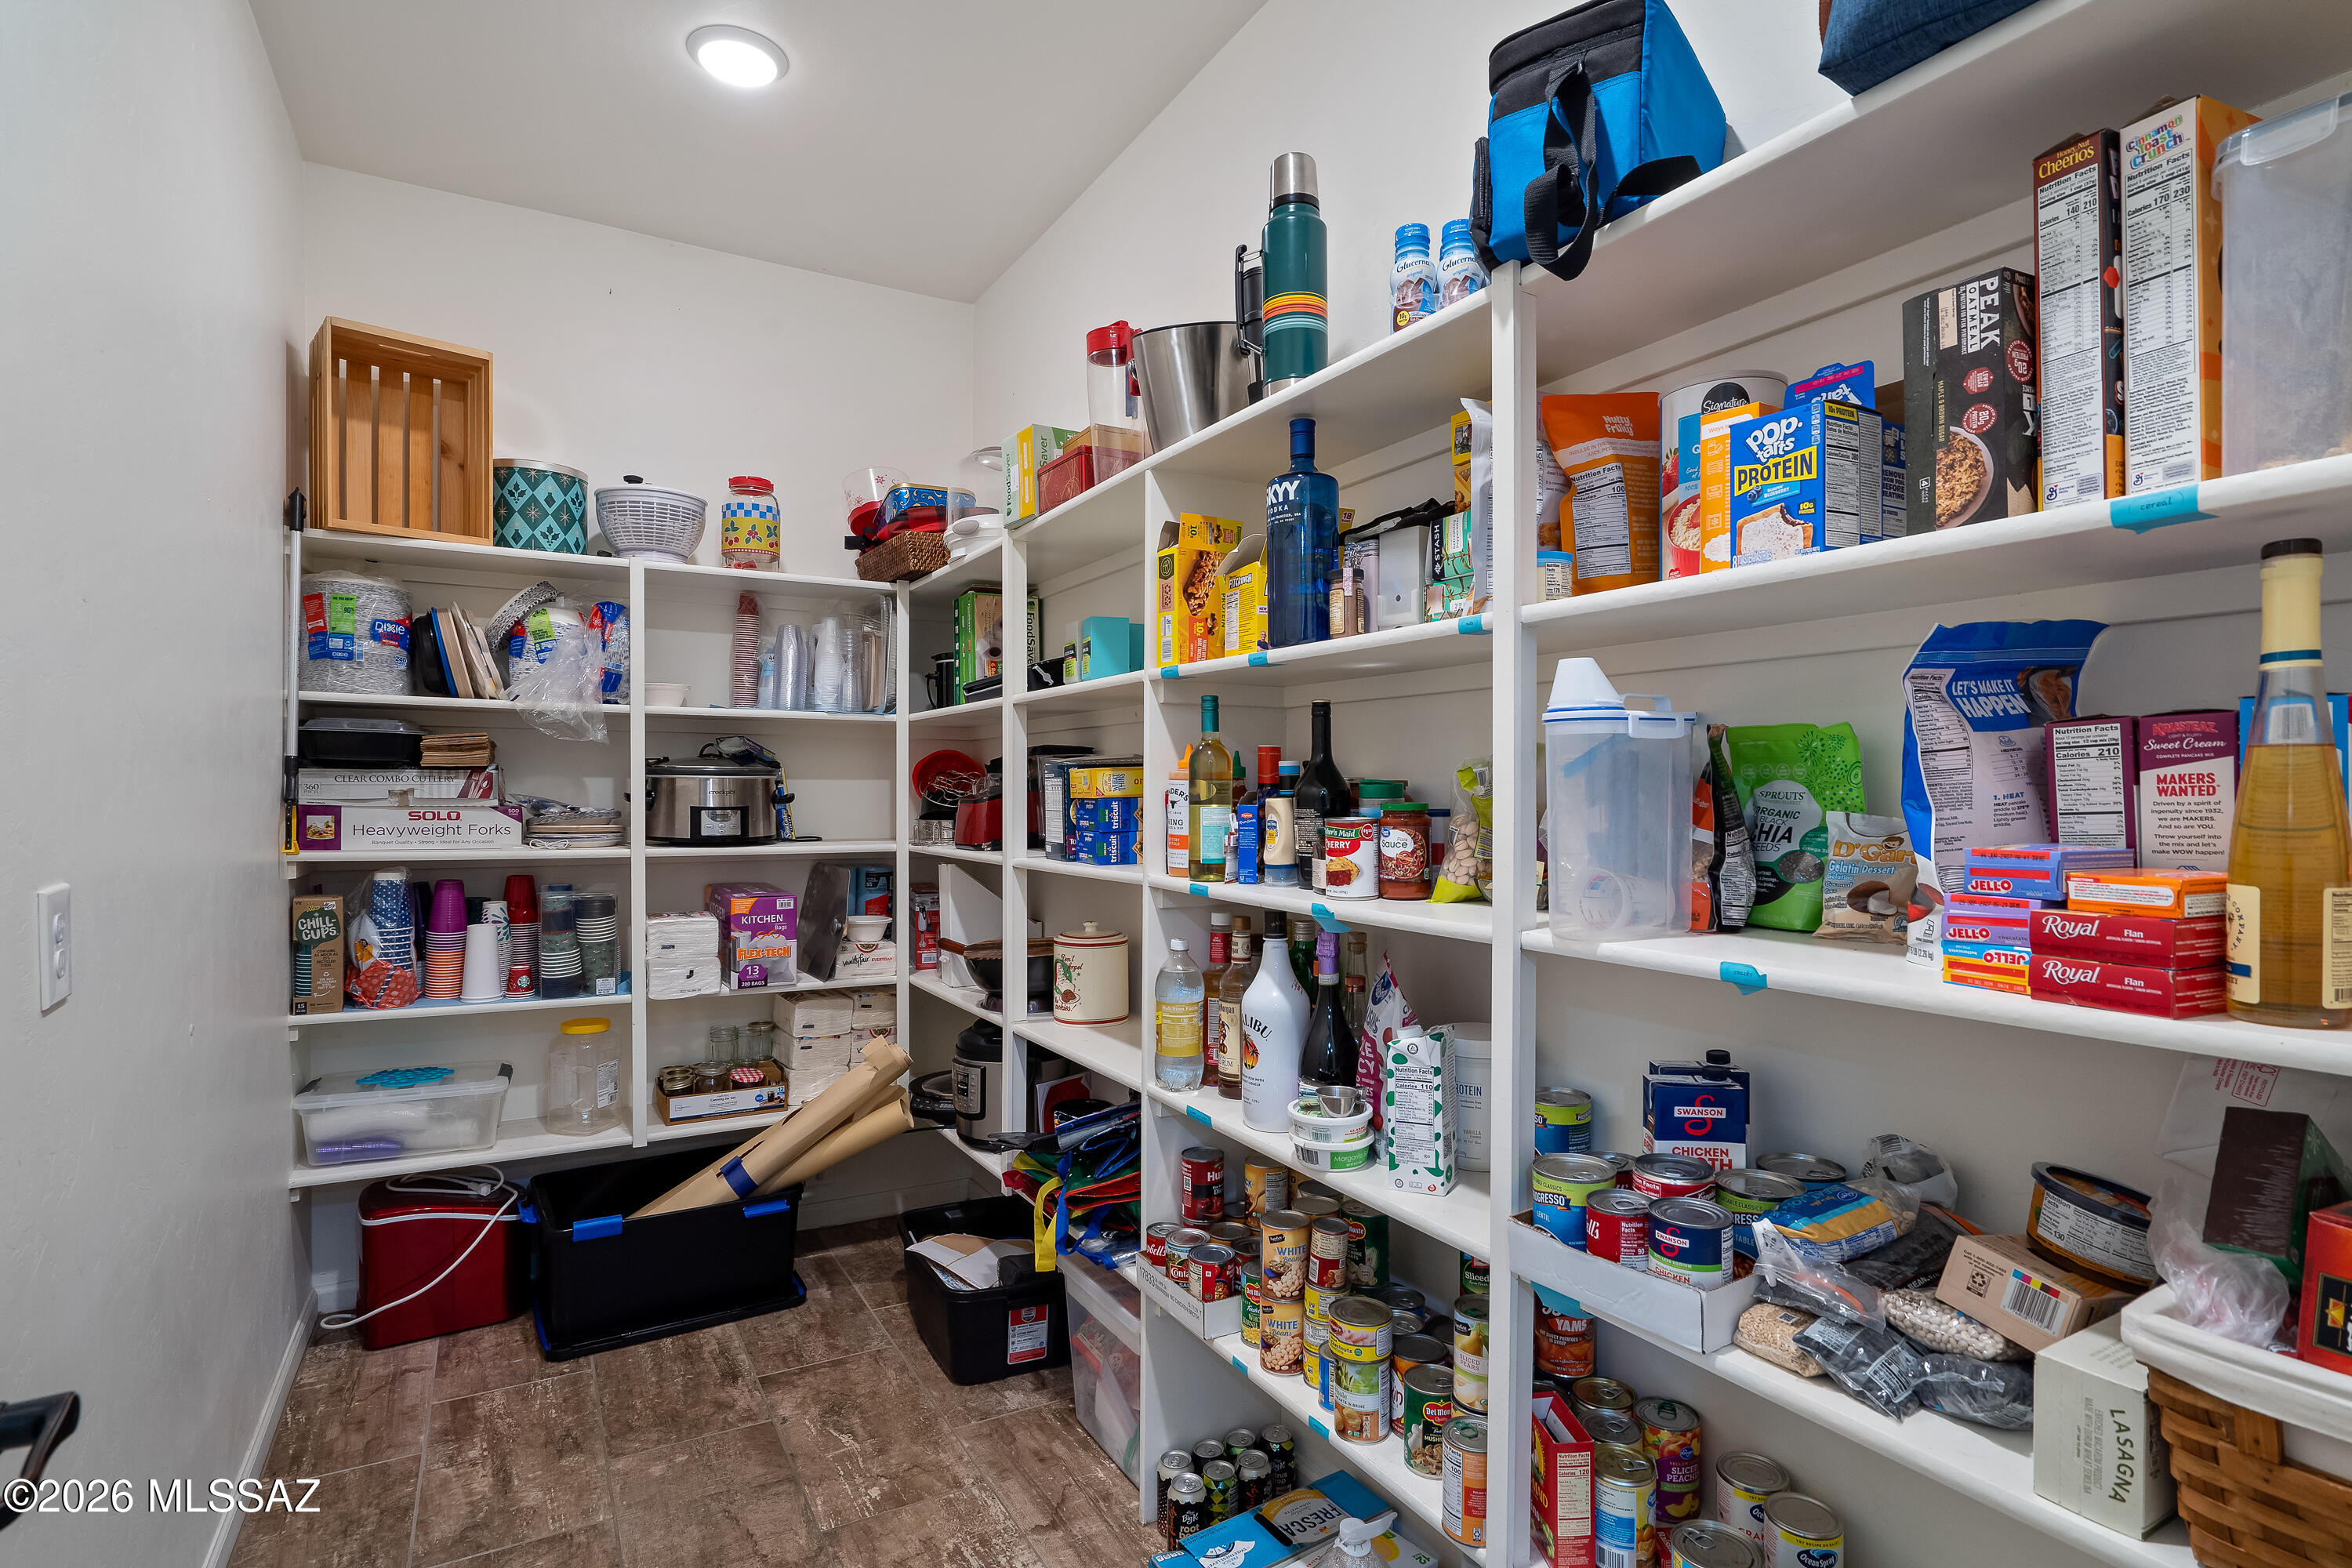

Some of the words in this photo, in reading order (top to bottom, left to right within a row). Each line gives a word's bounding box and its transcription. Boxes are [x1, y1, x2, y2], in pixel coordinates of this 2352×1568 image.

[2126, 115, 2183, 152] Cinnamon
[2057, 148, 2076, 158] Honey
[2078, 140, 2089, 149] Nut
[2139, 130, 2172, 154] Toast
[2131, 132, 2183, 169] Crunch
[2039, 146, 2094, 179] Cheerios
[2127, 163, 2162, 182] Nutrition
[2166, 152, 2190, 164] Facts
[2039, 176, 2071, 194] Nutrition
[2074, 166, 2096, 177] Facts
[2154, 193, 2169, 206] 170
[2173, 186, 2190, 198] 230
[2066, 205, 2080, 216] 140
[2083, 198, 2097, 209] 210
[1397, 259, 1430, 272] Glucerna
[1443, 256, 1476, 271] Glucerna
[1969, 287, 1978, 349] OATMEAL
[1980, 276, 2000, 350] PEAK
[1703, 398, 1748, 414] Signature
[1835, 407, 1855, 419] PROTEIN
[1978, 410, 1989, 425] 20g
[1569, 446, 1591, 456] INDULGE
[1571, 468, 1602, 483] Nutrition
[1603, 463, 1622, 474] Facts
[1738, 450, 1813, 491] PROTEIN
[1764, 487, 1790, 498] BLUEBERRY
[2140, 495, 2173, 511] cereal
[1951, 680, 1978, 695] LET'S
[1980, 679, 2006, 694] MAKE
[2006, 679, 2015, 691] IT
[1956, 693, 2031, 718] HAPPEN
[2095, 724, 2119, 733] Facts
[2152, 720, 2218, 736] KRUSTEAZ
[2143, 739, 2181, 751] Sweet
[2183, 737, 2227, 750] Cream
[2098, 747, 2120, 756] 210
[2156, 772, 2216, 785] MAKERS
[1759, 790, 1806, 801] SPROUTS
[2156, 785, 2216, 797] WANTED
[408, 811, 461, 821] SOLO
[1109, 800, 1119, 829] triscuit
[1753, 806, 1801, 820] ORGANIC
[1759, 815, 1788, 826] BLACK
[353, 823, 462, 838] Heavyweight
[468, 823, 511, 835] Forks
[1339, 828, 1356, 838] Maid
[1752, 824, 1793, 844] CHIA
[1108, 834, 1116, 863] triscuit
[1381, 840, 1408, 848] Sauce
[1752, 842, 1780, 852] SEEDS
[1828, 860, 1860, 874] Gelatin
[1861, 864, 1895, 876] Dessert
[1828, 872, 1854, 881] Gelatina
[298, 916, 336, 931] CHILL-
[741, 914, 783, 925] KITCHEN
[2042, 915, 2100, 940] Royal
[2124, 928, 2143, 938] Flan
[737, 946, 791, 961] FLEX-TECH
[746, 965, 759, 975] 13
[2042, 960, 2101, 985] Royal
[2125, 978, 2144, 987] Flan
[1677, 1108, 1723, 1116] SWANSON
[1334, 1153, 1363, 1163] Margarita
[1671, 1147, 1730, 1158] CHICKEN
[1543, 1181, 1563, 1192] CLASSICS
[1738, 1202, 1763, 1212] CLASSICS
[2045, 1192, 2071, 1210] Nutrition
[1537, 1210, 1550, 1222] LENTIL
[1657, 1232, 1687, 1247] SWANSON
[2053, 1230, 2065, 1242] 130
[1276, 1243, 1307, 1256] WHITE
[1465, 1271, 1490, 1282] Sliced
[1267, 1318, 1298, 1330] WHITE
[1555, 1318, 1587, 1332] YAMS
[1460, 1353, 1480, 1365] SLICED
[1460, 1359, 1480, 1371] PEARS
[2108, 1409, 2135, 1503] LASAGNA
[1450, 1465, 1461, 1475] 100
[1671, 1465, 1698, 1475] SLICED
[1279, 1504, 1344, 1537] FRESCA
[1180, 1524, 1200, 1533] root
[1800, 1553, 1820, 1568] Ocean
[1820, 1556, 1835, 1568] Spray
